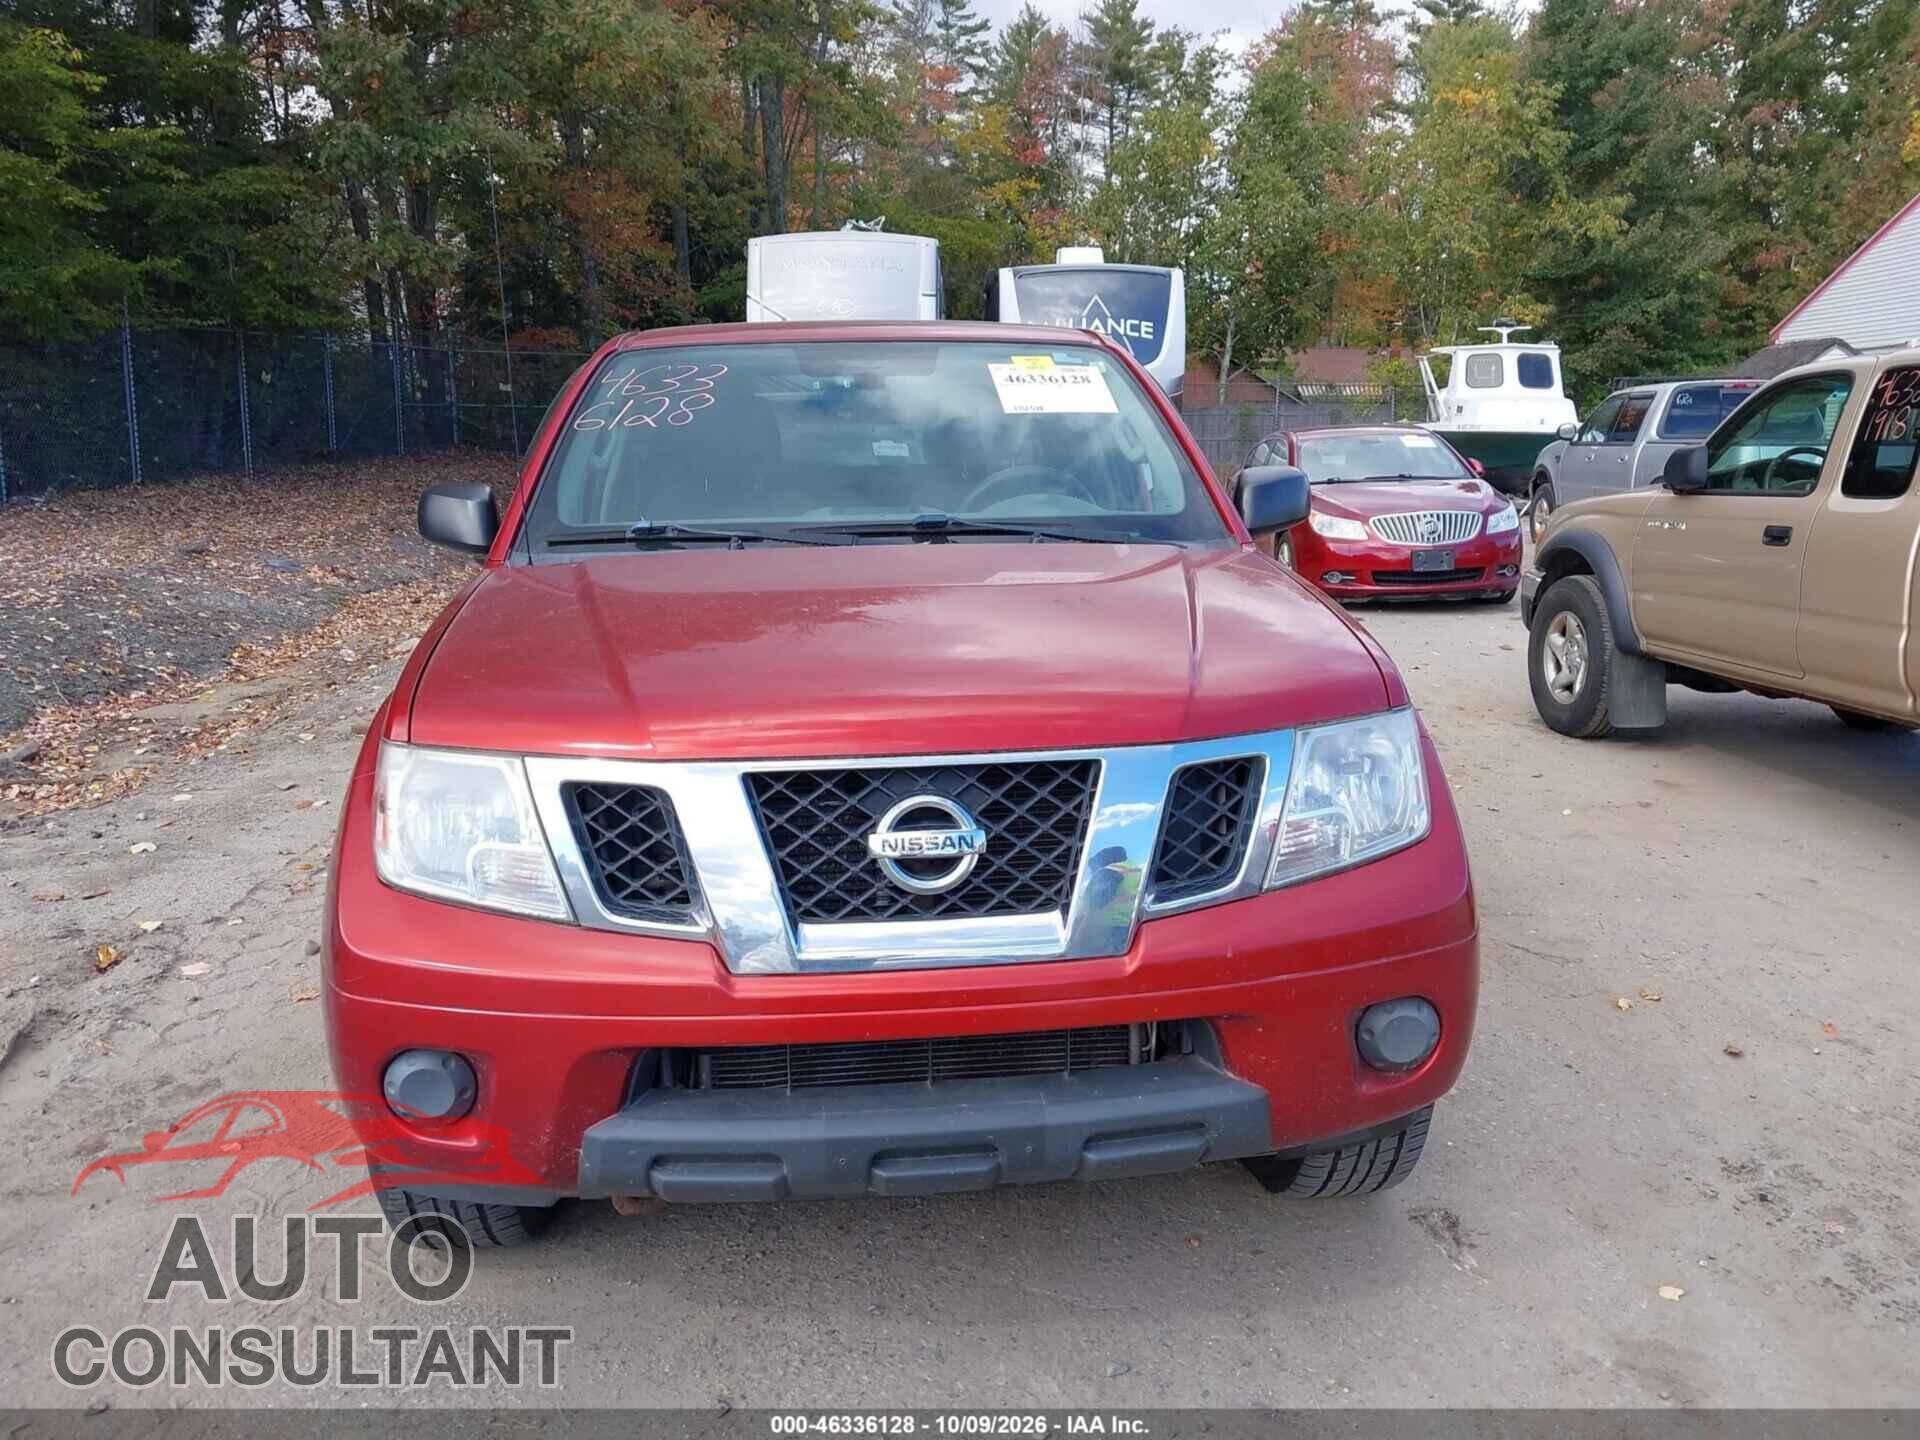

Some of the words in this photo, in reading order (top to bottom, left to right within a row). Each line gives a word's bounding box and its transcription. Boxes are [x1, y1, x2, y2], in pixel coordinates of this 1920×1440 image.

[1027, 317, 1154, 339] IANCE
[601, 364, 729, 398] 4633
[1004, 374, 1092, 384] 46336128
[1878, 370, 1920, 407] 463
[573, 393, 716, 431] 6128
[881, 834, 974, 853] NISSAN
